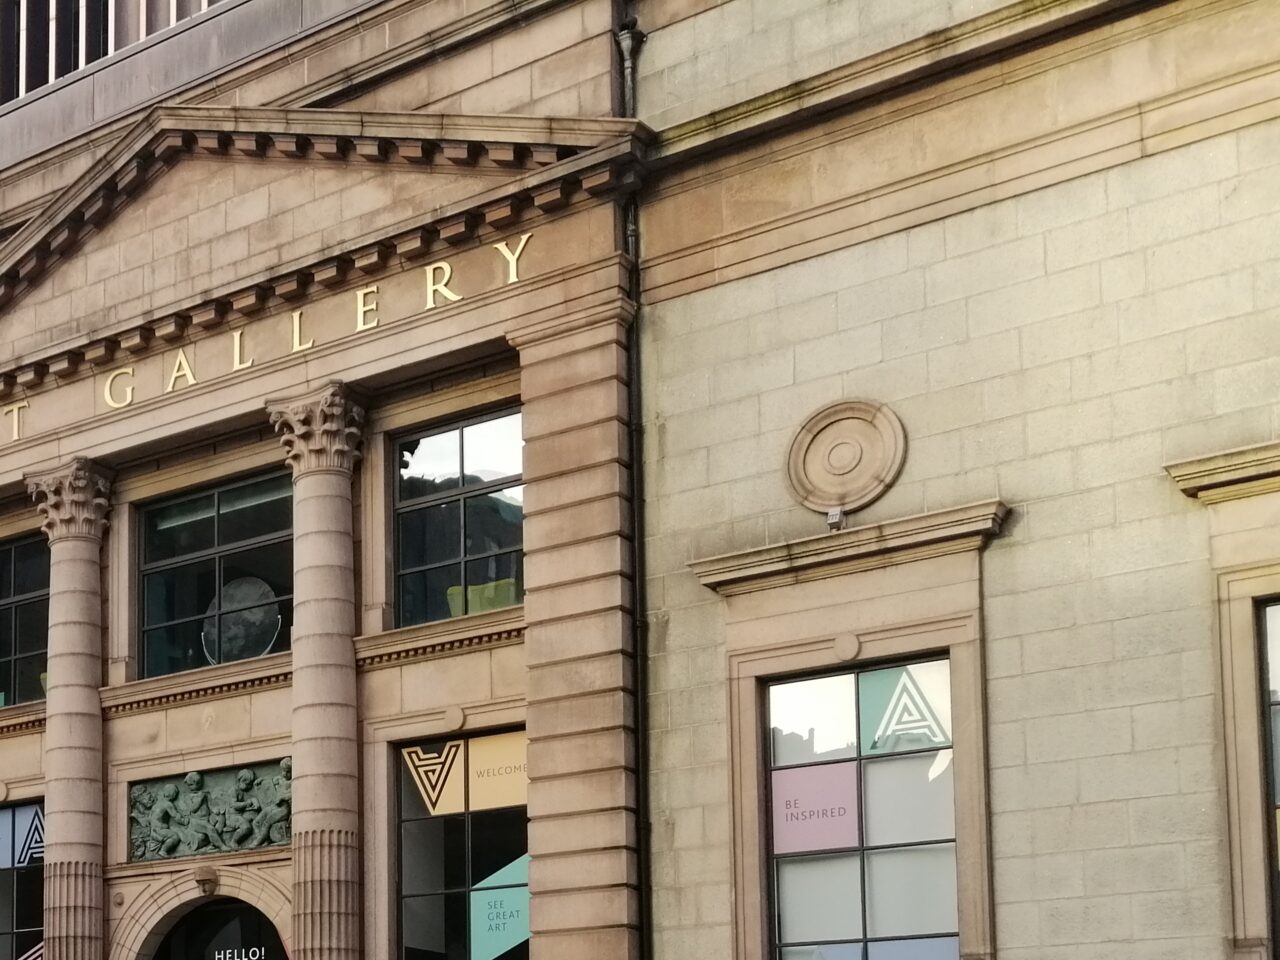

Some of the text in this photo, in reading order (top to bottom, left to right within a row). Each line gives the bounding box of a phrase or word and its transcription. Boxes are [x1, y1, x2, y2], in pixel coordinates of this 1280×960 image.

[103, 233, 534, 408] GALLERY
[785, 799, 800, 810] BE
[785, 806, 847, 822] INSPIRED
[487, 900, 505, 910] SEE
[487, 909, 520, 921] GREAT
[487, 922, 507, 932] ART
